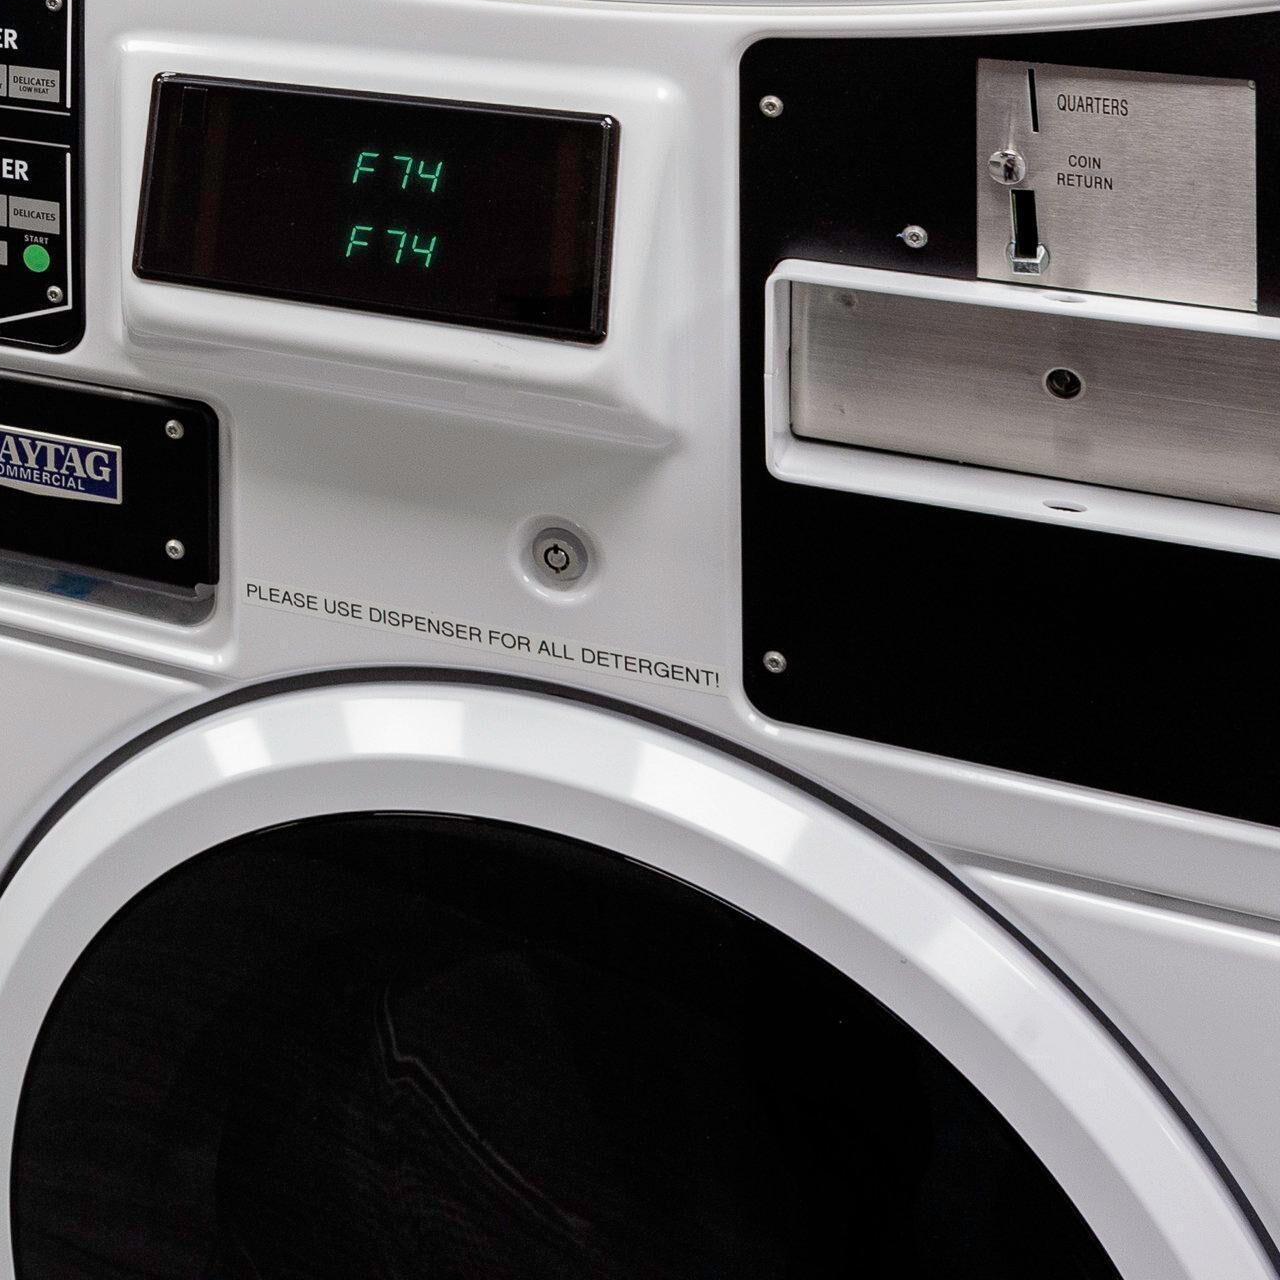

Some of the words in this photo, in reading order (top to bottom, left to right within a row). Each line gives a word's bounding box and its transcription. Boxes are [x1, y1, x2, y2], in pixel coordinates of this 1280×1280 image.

[13, 75, 56, 88] DELICATES
[19, 85, 33, 93] LOW
[33, 86, 49, 95] HEAT
[1056, 93, 1129, 117] QUARTERS
[1068, 154, 1102, 170] COIN
[352, 152, 380, 184] F
[393, 155, 444, 193] 74
[1056, 173, 1114, 191] RETURN
[13, 207, 56, 221] DELICATES
[23, 234, 49, 245] START
[345, 225, 374, 258] F
[386, 229, 437, 268] 74
[246, 583, 319, 612] PLEASE
[324, 598, 363, 620] USE
[369, 606, 482, 644] DISPENSER
[488, 630, 531, 653] FOR
[538, 640, 575, 661] ALL
[581, 648, 720, 688] DETERGENT!
